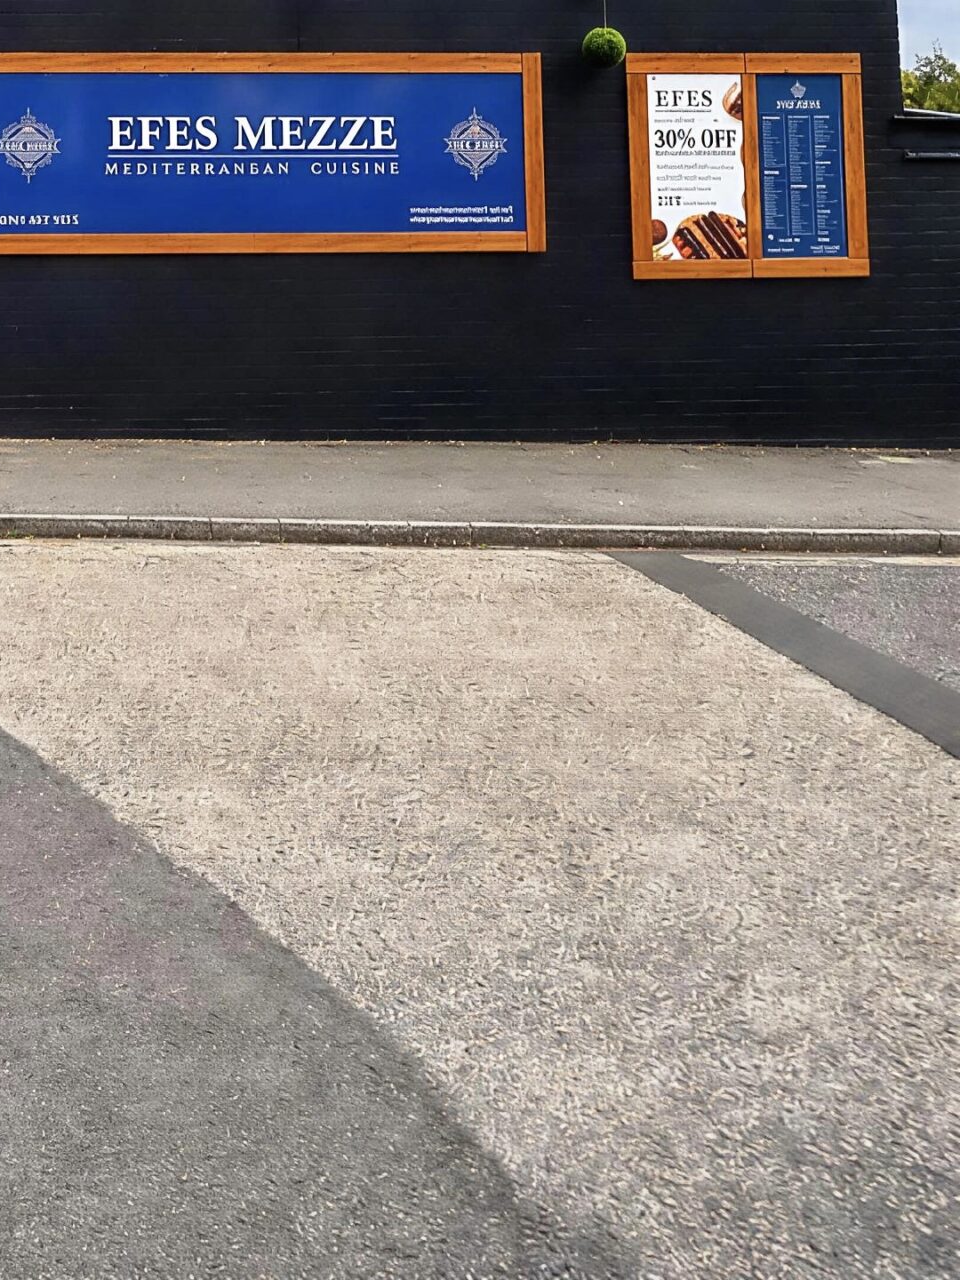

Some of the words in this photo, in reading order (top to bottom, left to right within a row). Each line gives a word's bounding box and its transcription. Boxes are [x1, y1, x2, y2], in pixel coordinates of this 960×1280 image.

[655, 90, 713, 107] EFES
[107, 116, 218, 150] EFES
[233, 116, 398, 150] MEZZE
[654, 128, 696, 149] 30%
[701, 128, 737, 149] OFF
[310, 161, 399, 175] CUISINE
